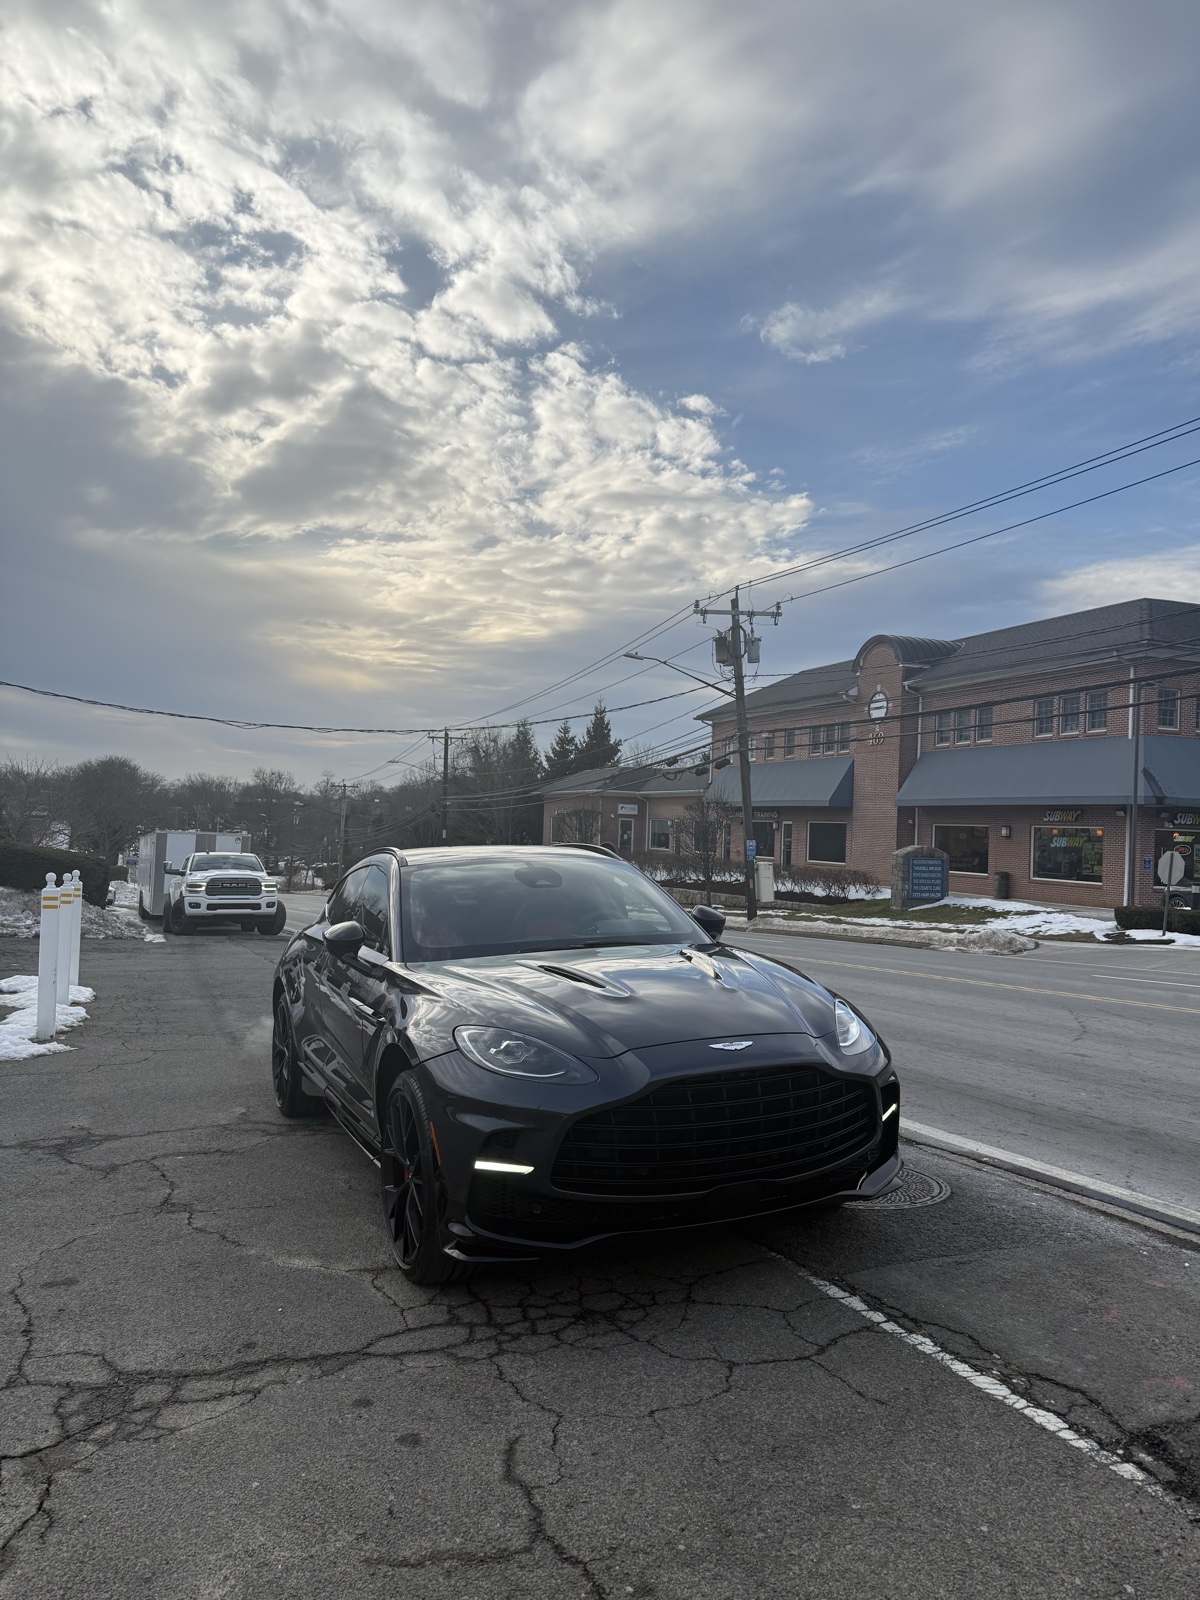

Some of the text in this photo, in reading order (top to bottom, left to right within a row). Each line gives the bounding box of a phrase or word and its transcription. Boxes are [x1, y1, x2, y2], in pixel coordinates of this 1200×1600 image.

[867, 731, 884, 746] 469
[1043, 810, 1081, 822] SUBWAY
[1050, 836, 1087, 848] SUBWAY
